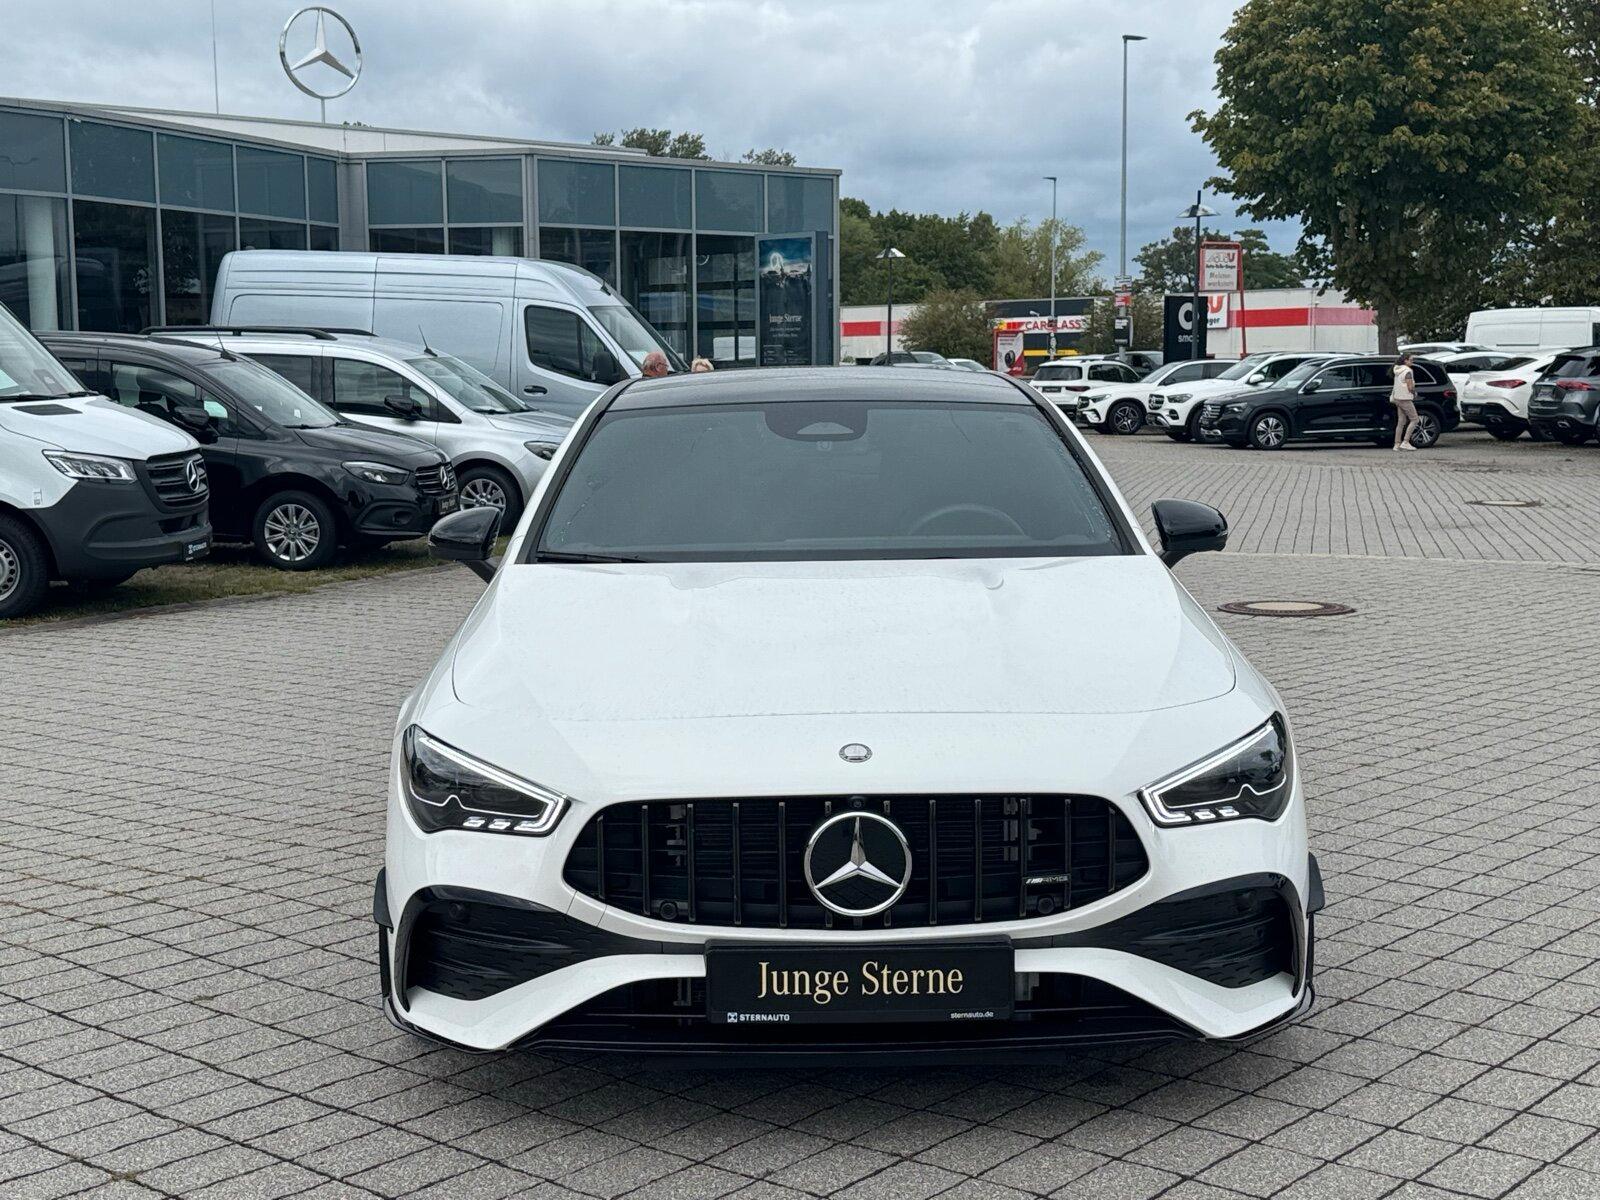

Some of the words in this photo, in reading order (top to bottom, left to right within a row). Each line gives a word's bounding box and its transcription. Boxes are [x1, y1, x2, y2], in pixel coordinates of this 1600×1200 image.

[757, 961, 849, 1005] Junge
[861, 960, 964, 996] Sterne
[739, 1013, 790, 1022] STERNAUTO
[950, 1011, 994, 1019] sternauto.de
